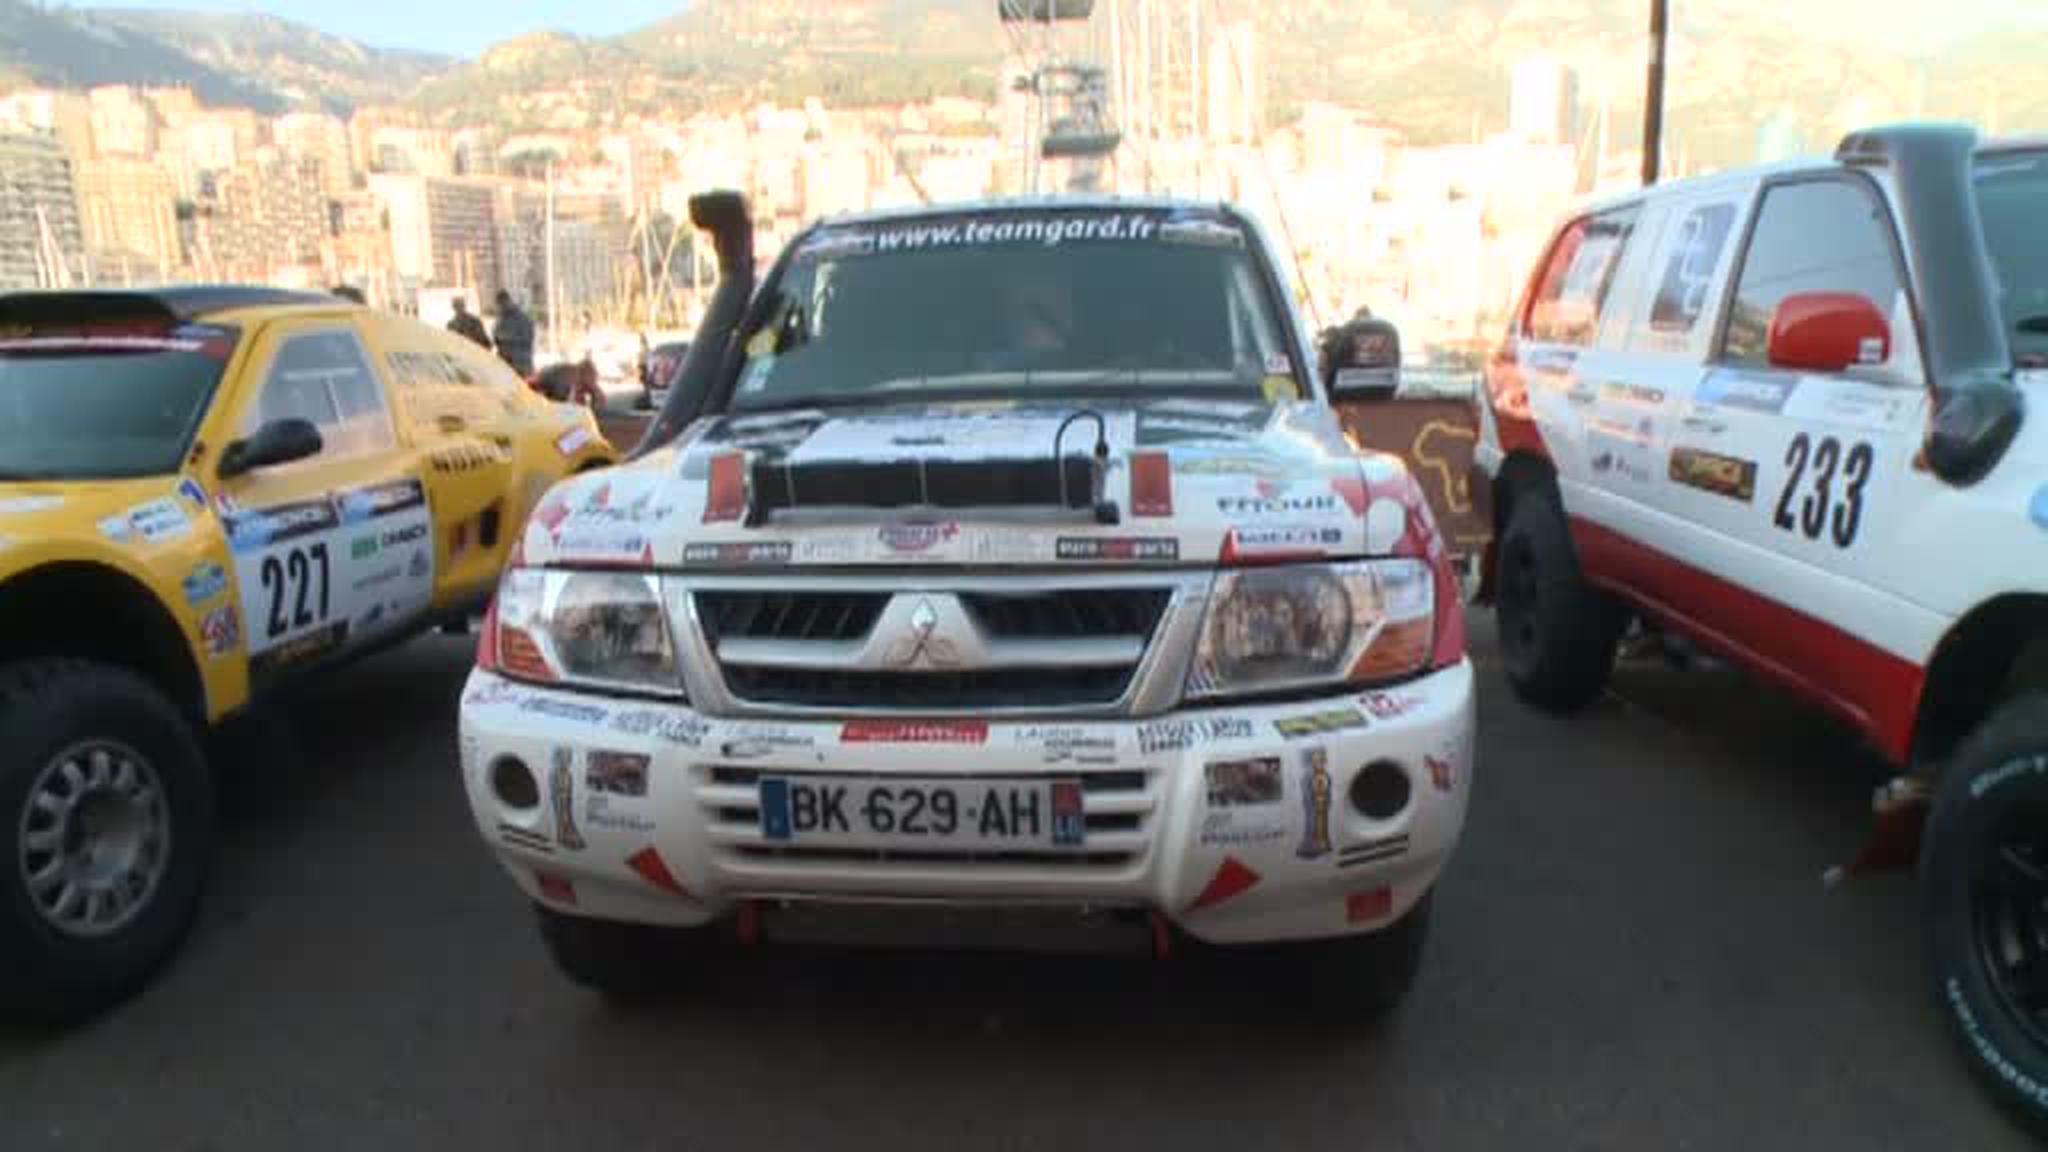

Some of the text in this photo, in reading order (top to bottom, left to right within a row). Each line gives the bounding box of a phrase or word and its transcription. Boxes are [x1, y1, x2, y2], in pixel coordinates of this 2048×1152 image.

[878, 215, 1152, 248] www.teamgard.fr
[1774, 431, 1873, 549] 233
[261, 543, 330, 637] 227
